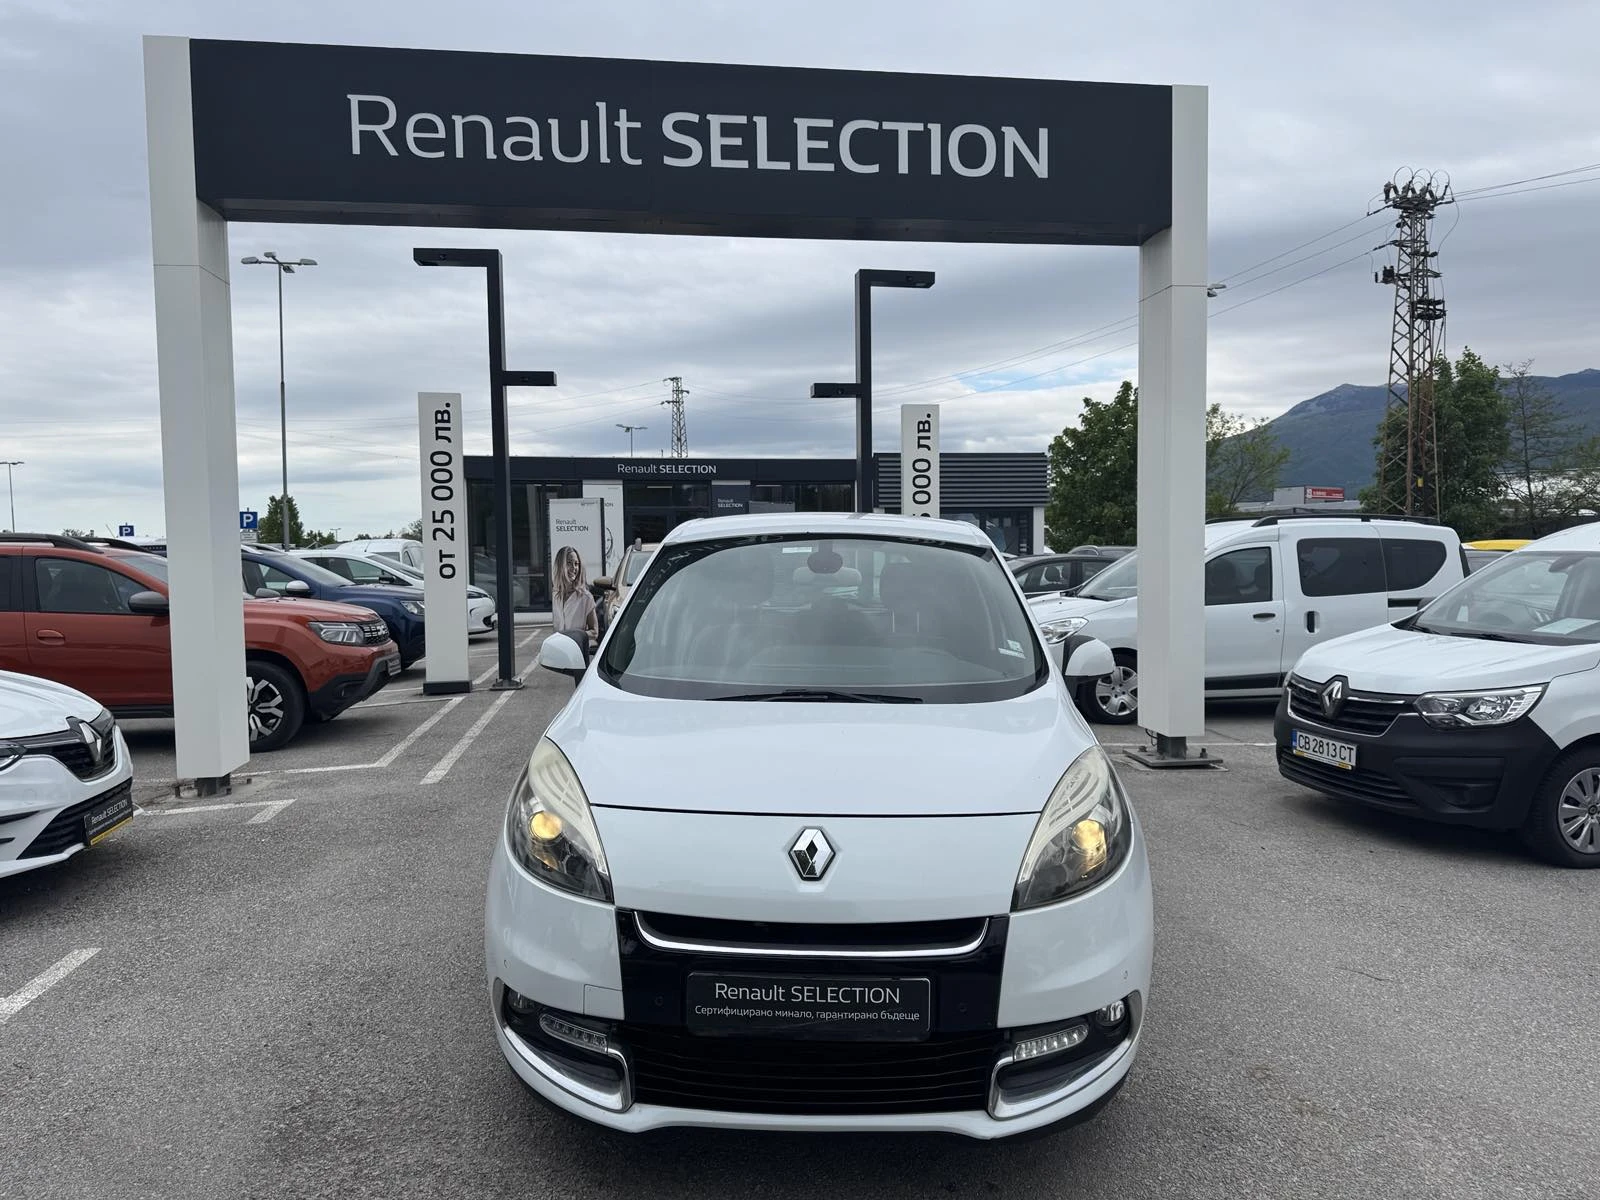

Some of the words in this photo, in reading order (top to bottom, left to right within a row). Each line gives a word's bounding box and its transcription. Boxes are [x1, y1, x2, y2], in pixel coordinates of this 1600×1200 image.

[346, 93, 643, 166] Renault
[661, 111, 1050, 179] SELECTION
[435, 402, 452, 443] лв.
[917, 413, 931, 451] лв.
[430, 450, 453, 501] 000
[617, 464, 657, 474] Renault
[660, 465, 717, 474] SELECTION
[912, 458, 931, 505] 000
[122, 527, 131, 536] P
[243, 514, 254, 528] P
[432, 509, 455, 541] 25
[439, 549, 456, 579] от
[1298, 734, 1311, 751] CB
[1312, 739, 1337, 758] 2813
[1339, 745, 1354, 763] CT
[715, 983, 786, 1002] Renault
[791, 986, 900, 1004] SELECTION
[695, 1005, 773, 1018] Сертифицирано
[775, 1010, 814, 1019] минало,
[816, 1010, 879, 1022] гарантирано
[880, 1009, 920, 1021] бъдеще
